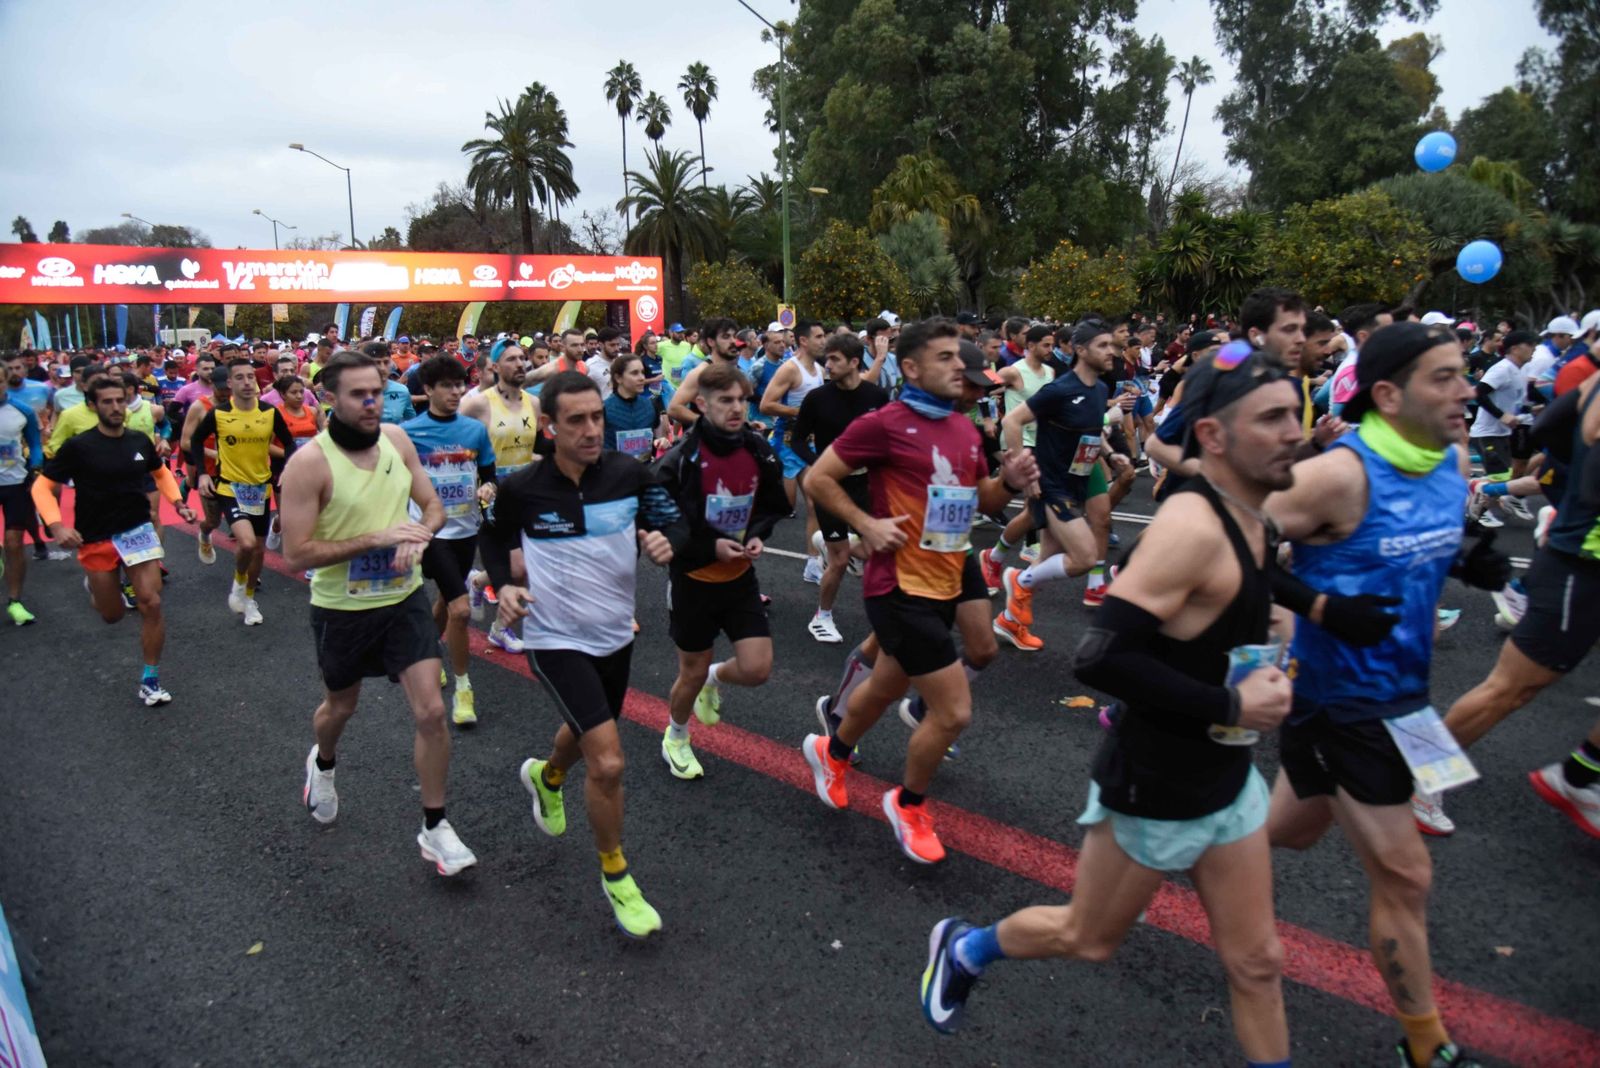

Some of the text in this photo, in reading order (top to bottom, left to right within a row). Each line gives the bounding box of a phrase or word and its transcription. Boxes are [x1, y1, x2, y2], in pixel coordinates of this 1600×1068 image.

[94, 264, 161, 285] HOKA
[414, 268, 463, 284] HOKA
[717, 507, 748, 524] 1793
[939, 503, 972, 523] 1813
[122, 533, 152, 549] 2439
[360, 551, 395, 572] 331
